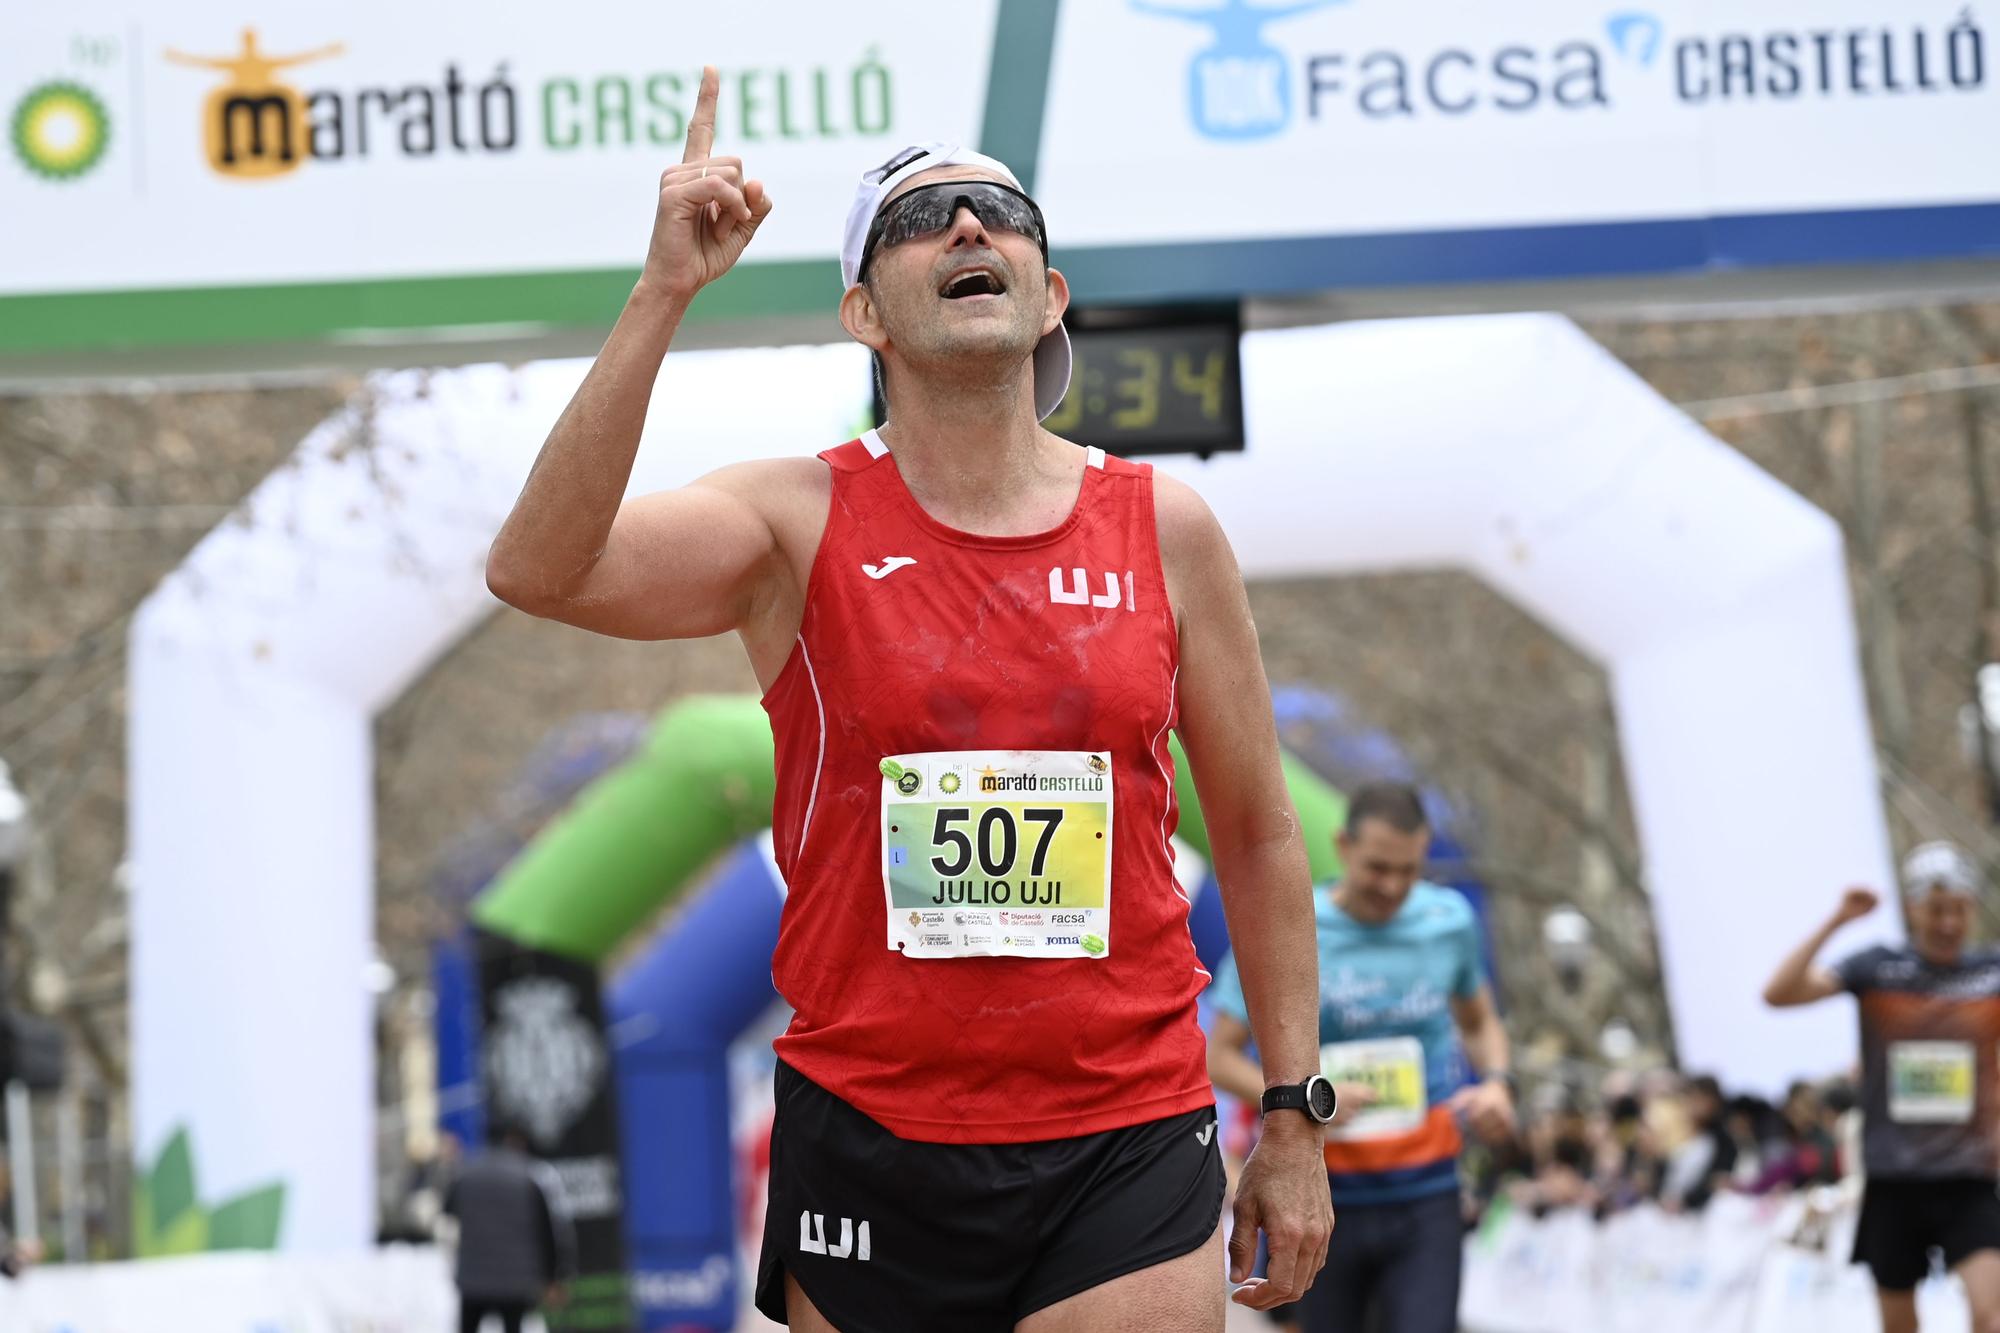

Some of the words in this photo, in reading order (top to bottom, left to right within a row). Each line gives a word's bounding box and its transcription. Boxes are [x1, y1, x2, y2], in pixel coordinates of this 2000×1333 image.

[1674, 5, 1984, 102] CASTELLÓ
[219, 60, 518, 167] marató
[1048, 566, 1136, 612] UJI
[981, 772, 1037, 791] marató
[1039, 774, 1104, 792] CASTELLÓ
[895, 851, 900, 864] L
[931, 807, 1064, 877] 507
[932, 880, 1011, 905] JULIO
[1021, 880, 1061, 905] UJI
[1010, 912, 1042, 920] Diputació
[799, 1209, 871, 1261] UJI
